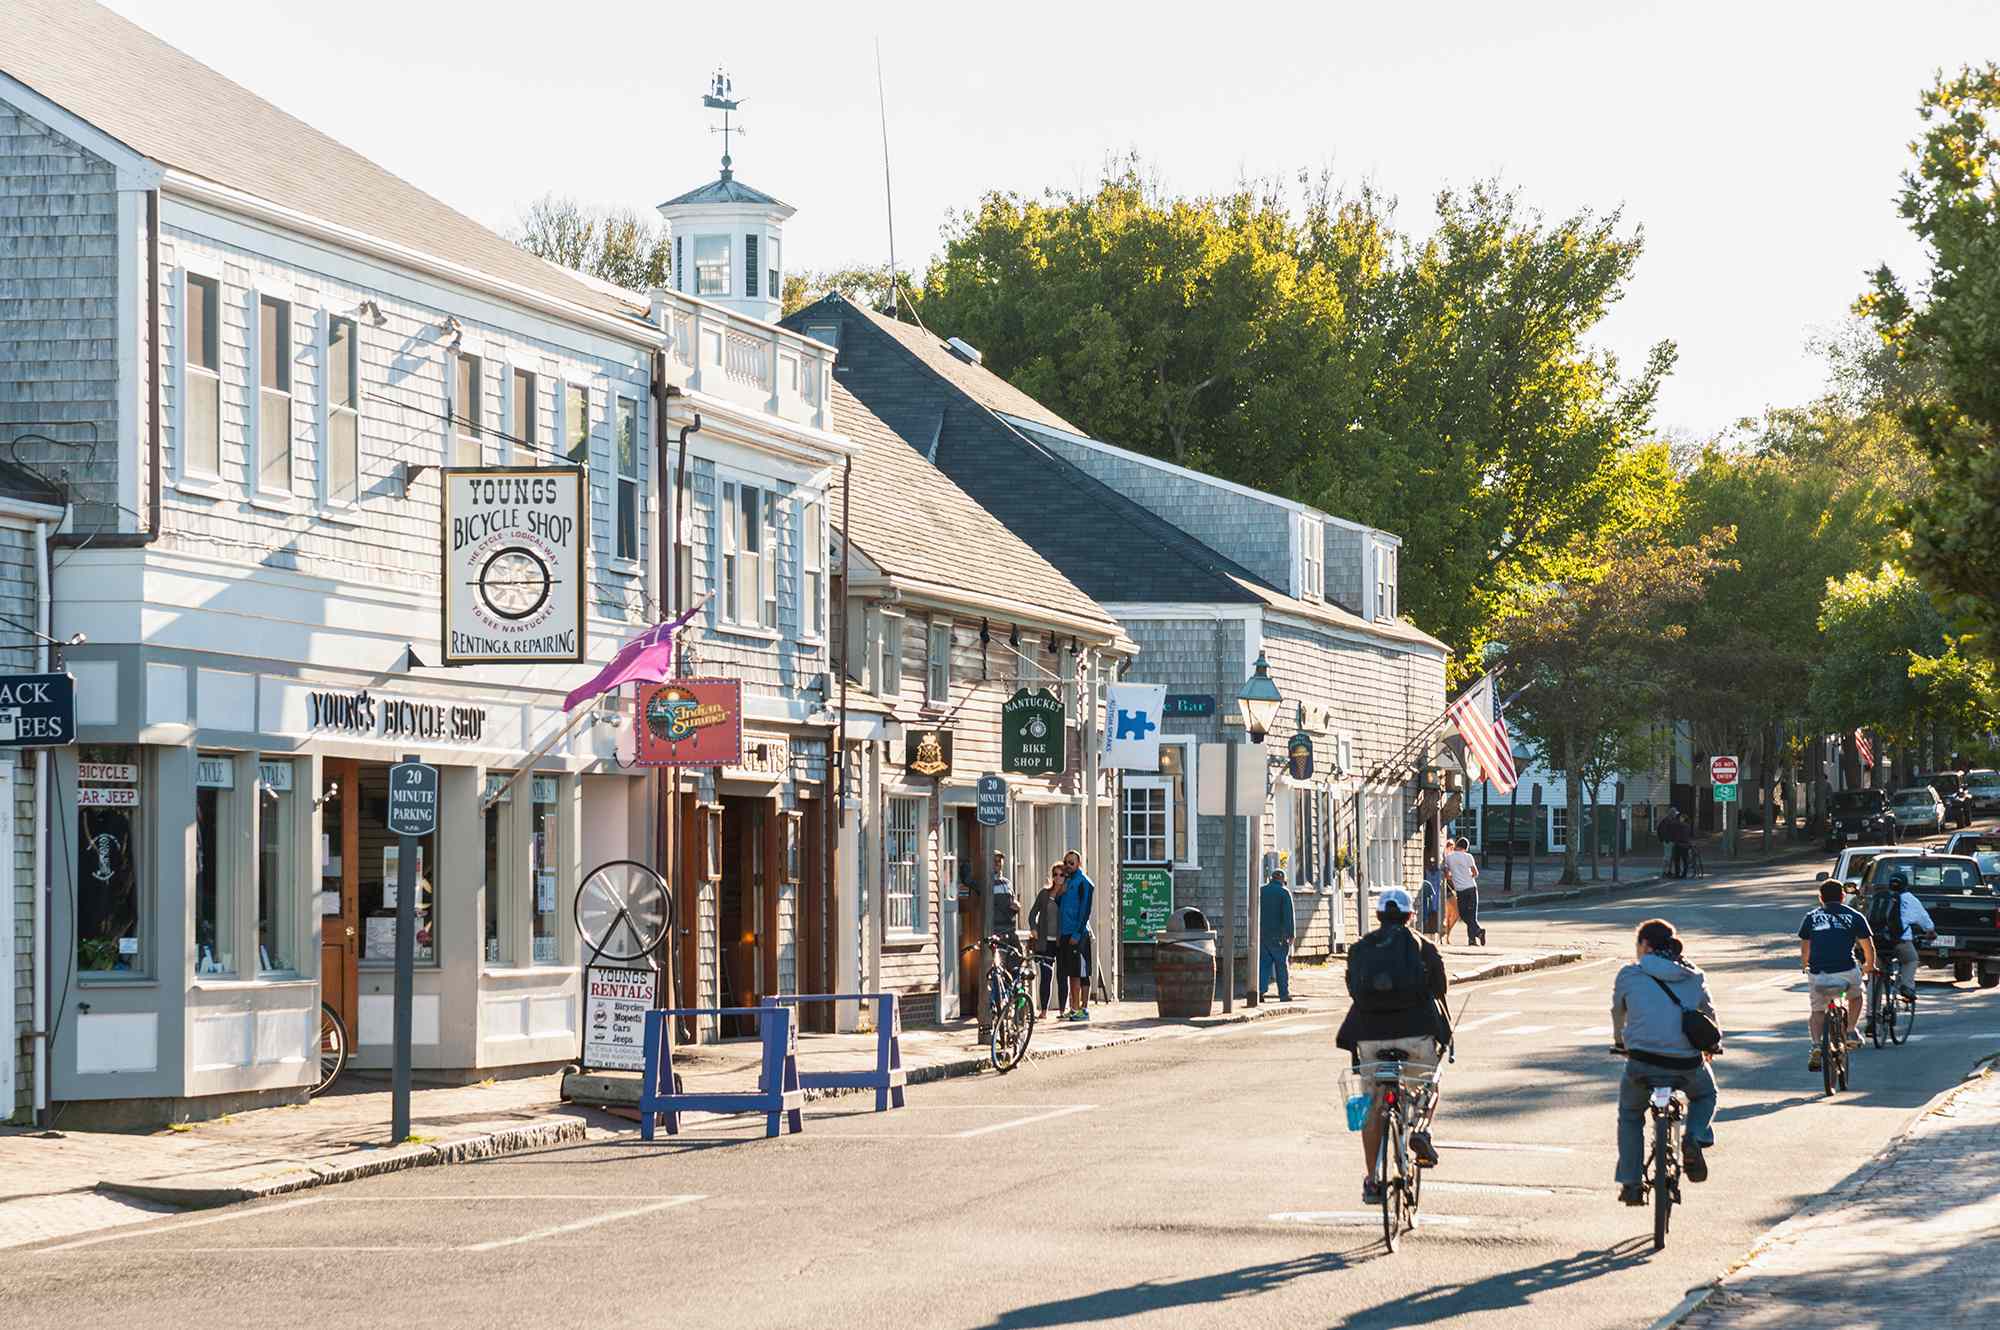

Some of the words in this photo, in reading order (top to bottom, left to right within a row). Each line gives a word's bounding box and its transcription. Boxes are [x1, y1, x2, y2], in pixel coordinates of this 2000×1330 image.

[469, 479, 557, 504] YOUNGS
[454, 508, 520, 551] BICYCLE
[527, 510, 573, 547] SHOP
[467, 551, 480, 567] THE
[544, 546, 559, 566] WAY
[472, 605, 484, 617] TO
[483, 616, 499, 630] SEE
[501, 604, 556, 633] NANTUCKET
[452, 630, 502, 654] RENTING
[514, 629, 575, 654] REPAIRING
[674, 704, 723, 719] Indian
[1005, 697, 1063, 713] NANTUCKET
[1178, 700, 1206, 711] Bar
[312, 689, 376, 732] YOUNG'S
[383, 699, 446, 738] BICYCLE
[451, 705, 486, 741] SHOP
[672, 713, 727, 734] Summer
[1022, 744, 1047, 753] BIKE
[1014, 757, 1041, 767] SHOP
[80, 765, 129, 780] BICYCLE
[406, 769, 422, 785] 20
[987, 780, 998, 790] 20
[79, 790, 135, 804] AR-JEEP
[393, 789, 434, 803] MINUTE
[980, 794, 1005, 803] MINUTE
[393, 807, 433, 822] PARKING
[980, 806, 1004, 815] PARKING
[1148, 873, 1161, 881] BAR
[591, 982, 653, 1000] RENTALS
[614, 1003, 645, 1012] Bicycles
[613, 1013, 643, 1023] Mopeds
[612, 1024, 631, 1033] Cars
[612, 1035, 633, 1044] Jeeps
